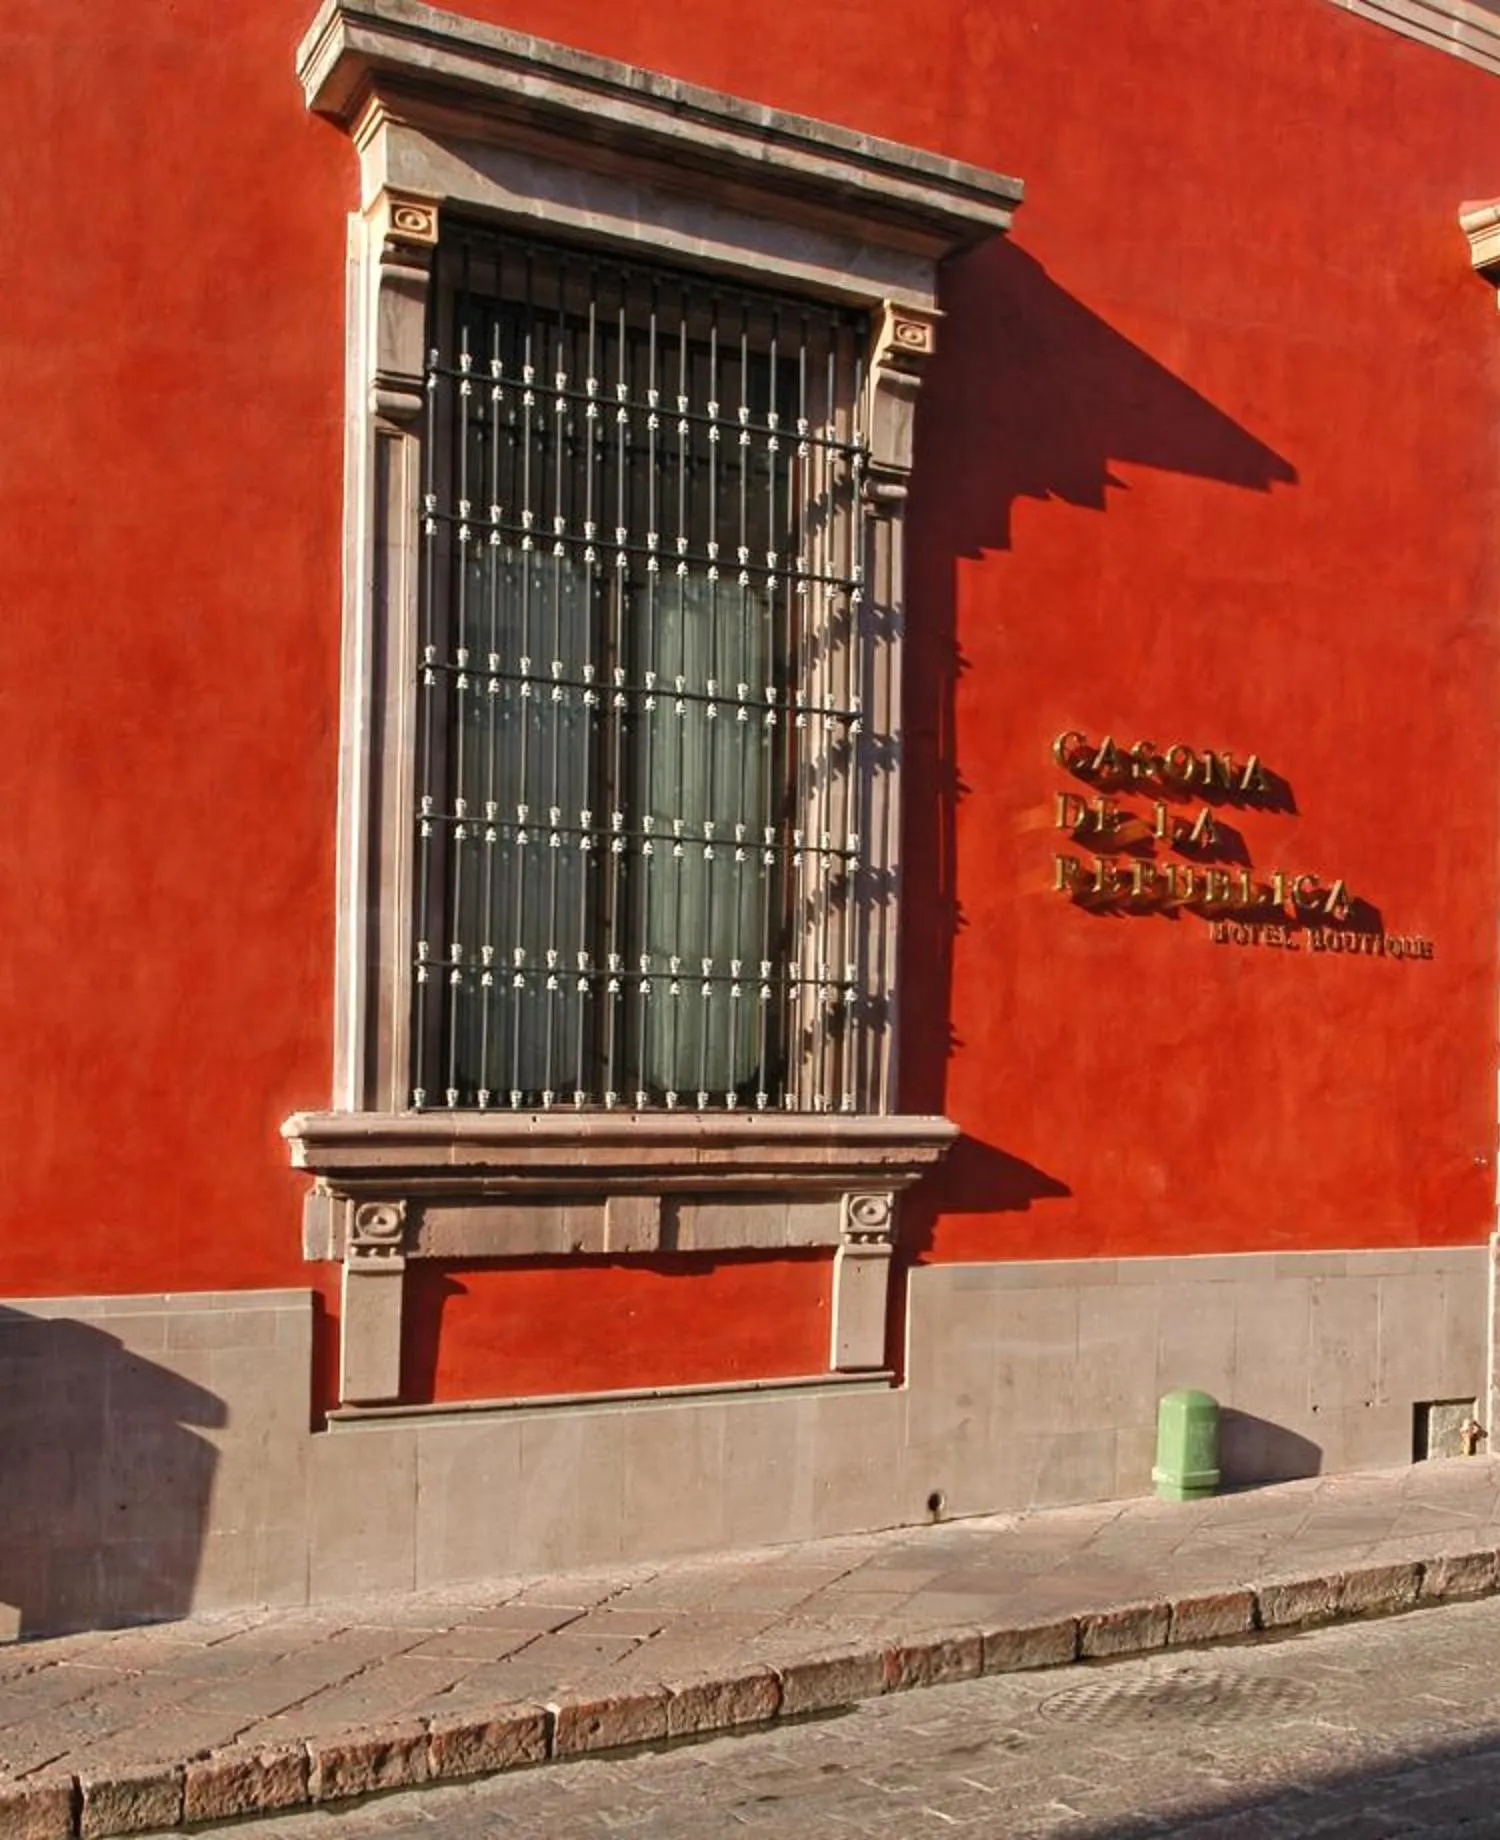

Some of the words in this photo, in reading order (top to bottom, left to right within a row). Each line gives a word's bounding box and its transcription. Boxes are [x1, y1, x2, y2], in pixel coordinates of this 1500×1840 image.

[1053, 731, 1268, 790] CASONA
[1055, 792, 1122, 833] DE
[1153, 800, 1218, 847] LA
[1054, 855, 1350, 918] REPUBLICA
[1208, 919, 1300, 949] HOTEL
[1301, 925, 1434, 960] BOUTIQUE
